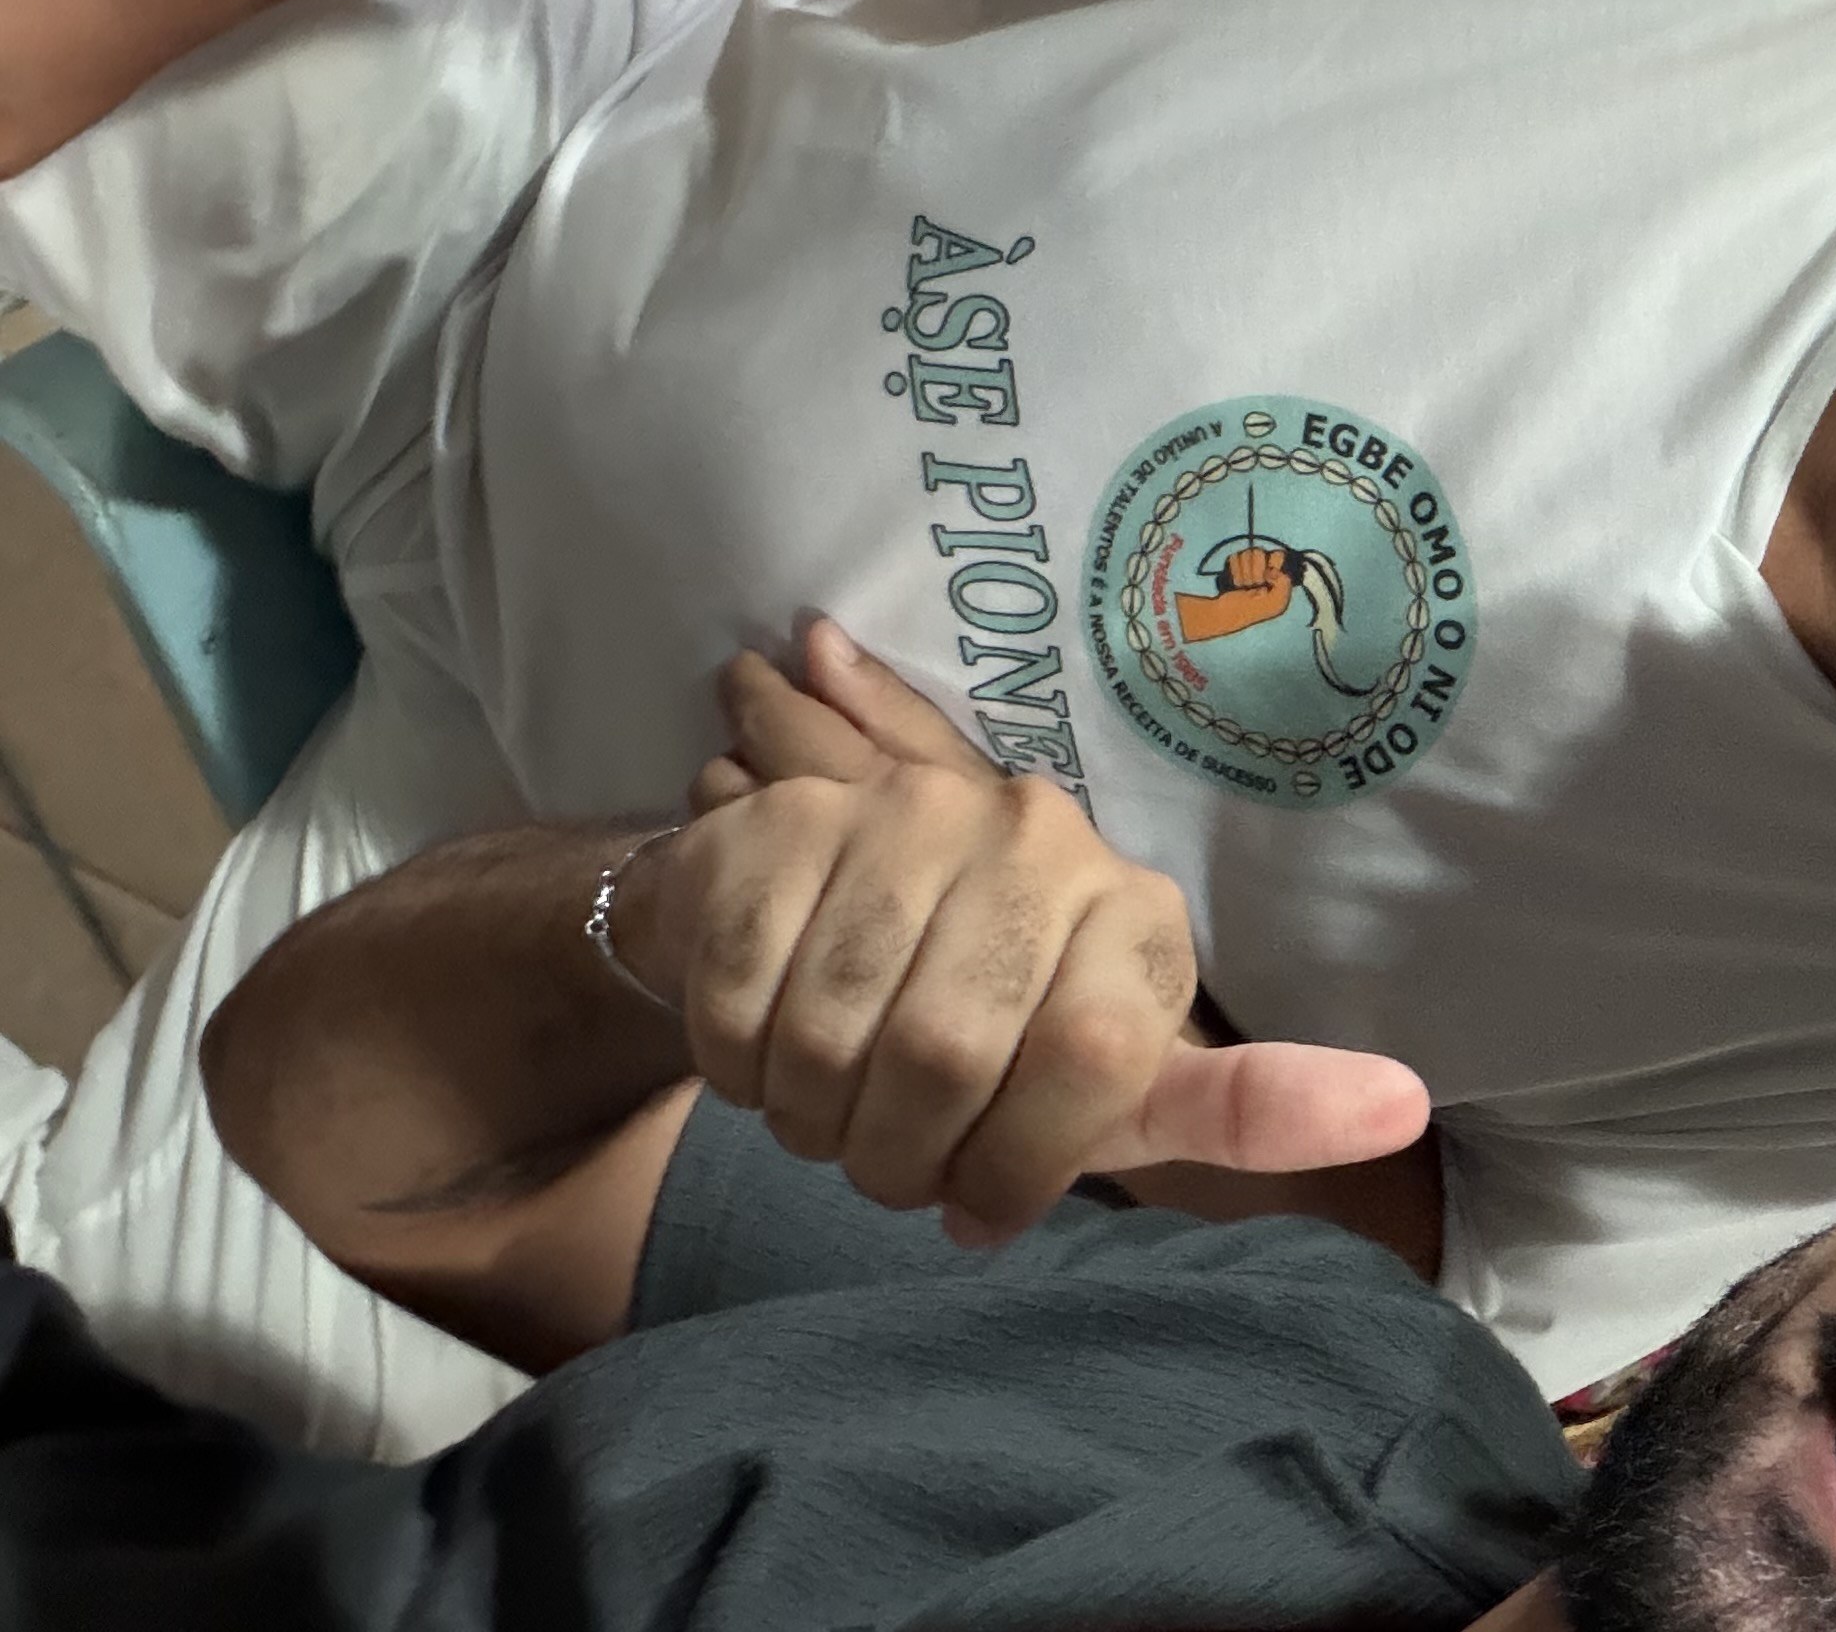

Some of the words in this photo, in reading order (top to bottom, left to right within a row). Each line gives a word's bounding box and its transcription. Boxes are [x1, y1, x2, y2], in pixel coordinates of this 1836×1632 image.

[1153, 426, 1208, 465] UNIÃO
[1209, 421, 1222, 438] A
[1302, 413, 1414, 490] EGBE
[1130, 460, 1156, 485] DE
[1094, 482, 1140, 573] TALENTOS
[1410, 492, 1464, 601] OMO
[1089, 594, 1103, 608] A
[1091, 577, 1109, 590] É
[921, 451, 1098, 830] PIONE
[1089, 614, 1119, 681] NOSSA
[1157, 620, 1176, 650] em
[1434, 620, 1466, 650] O
[1112, 680, 1172, 747] RECEITA
[1410, 664, 1457, 723] NI
[1174, 741, 1200, 763] DE
[1339, 723, 1419, 790] ODE
